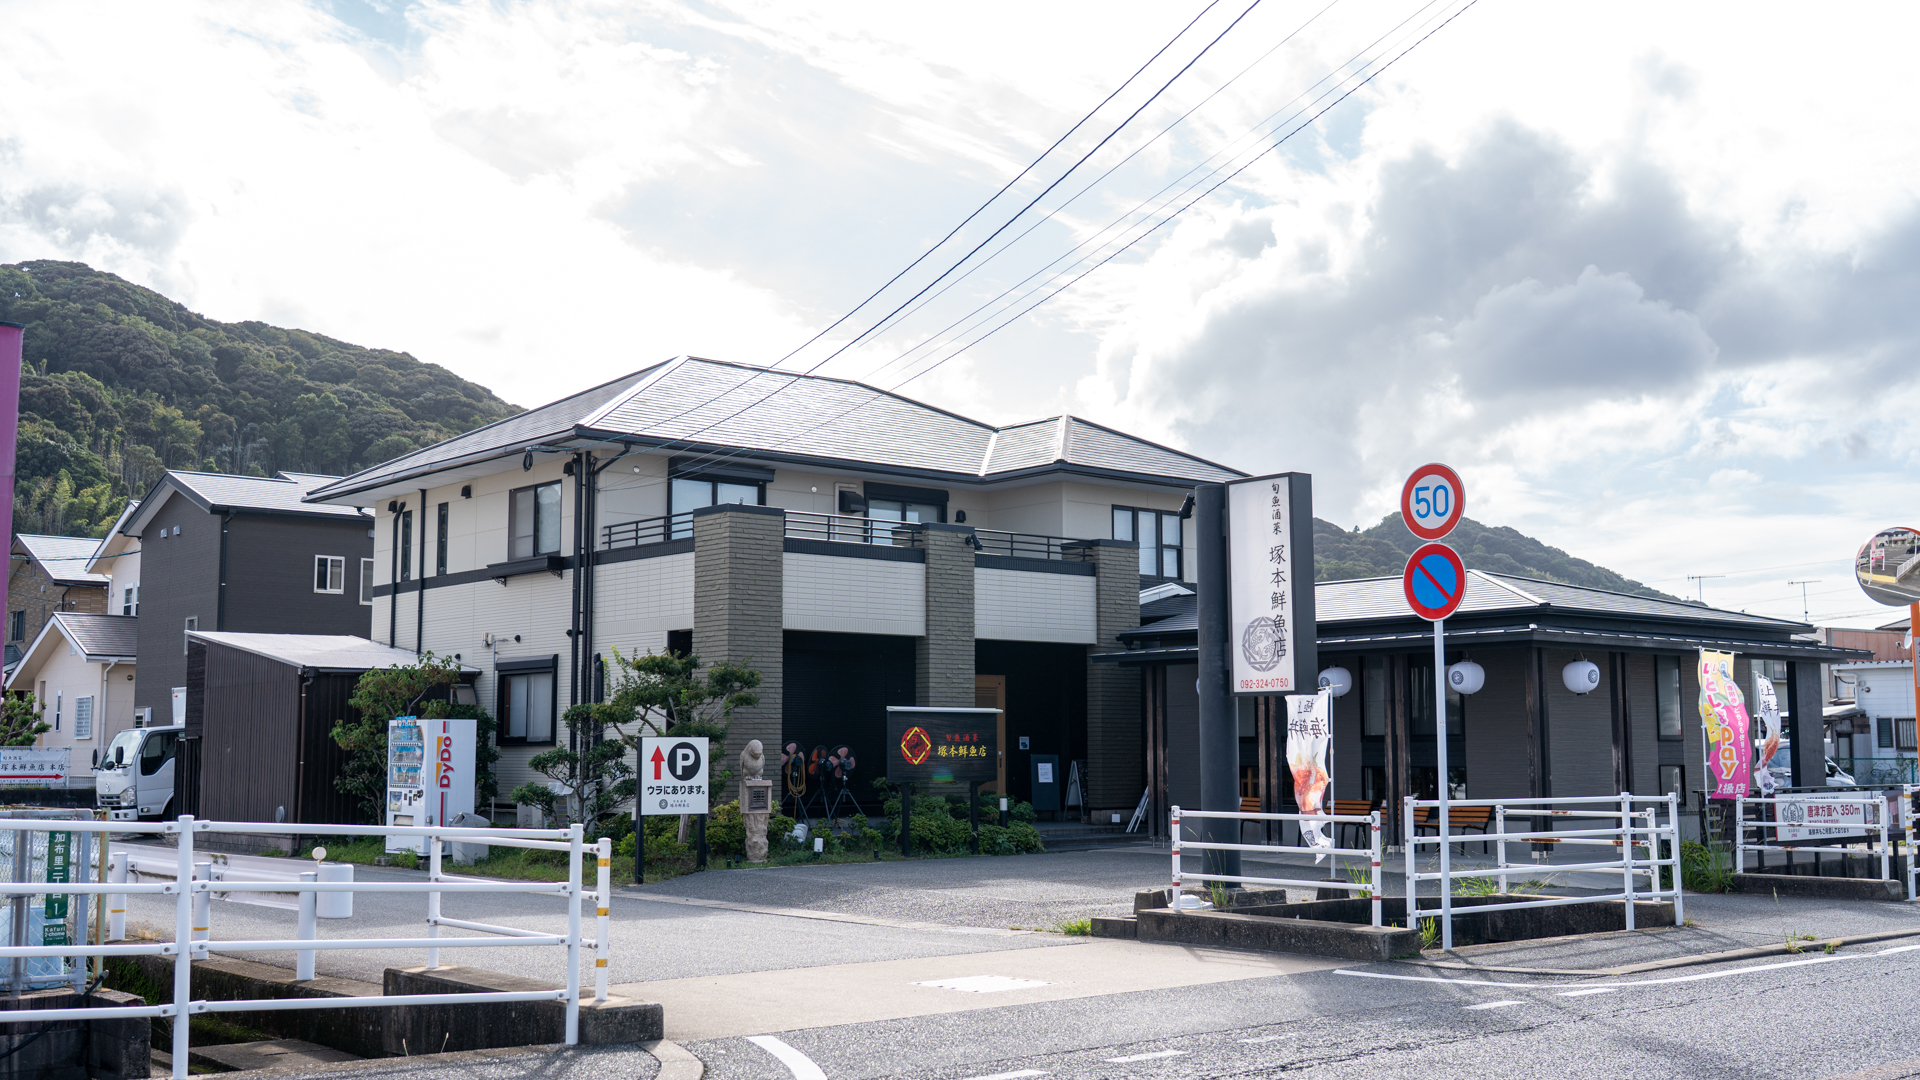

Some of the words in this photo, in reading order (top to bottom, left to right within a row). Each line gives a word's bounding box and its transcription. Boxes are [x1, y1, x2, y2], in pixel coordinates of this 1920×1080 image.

[1271, 482, 1282, 535] 旬魚酒菜
[1415, 484, 1449, 519] 50
[1269, 544, 1288, 658] 塚本鮮魚店
[1240, 677, 1289, 690] 092-324-0750
[676, 748, 695, 775] P
[938, 745, 986, 758] 塚本鮮魚店
[1, 763, 45, 771] 塚本鮮魚店
[50, 763, 65, 771] 本店
[439, 736, 455, 788] DyDo
[647, 785, 705, 795] ウラにあります。
[1807, 804, 1838, 818] 唐津方面へ
[1840, 804, 1861, 816] 350m
